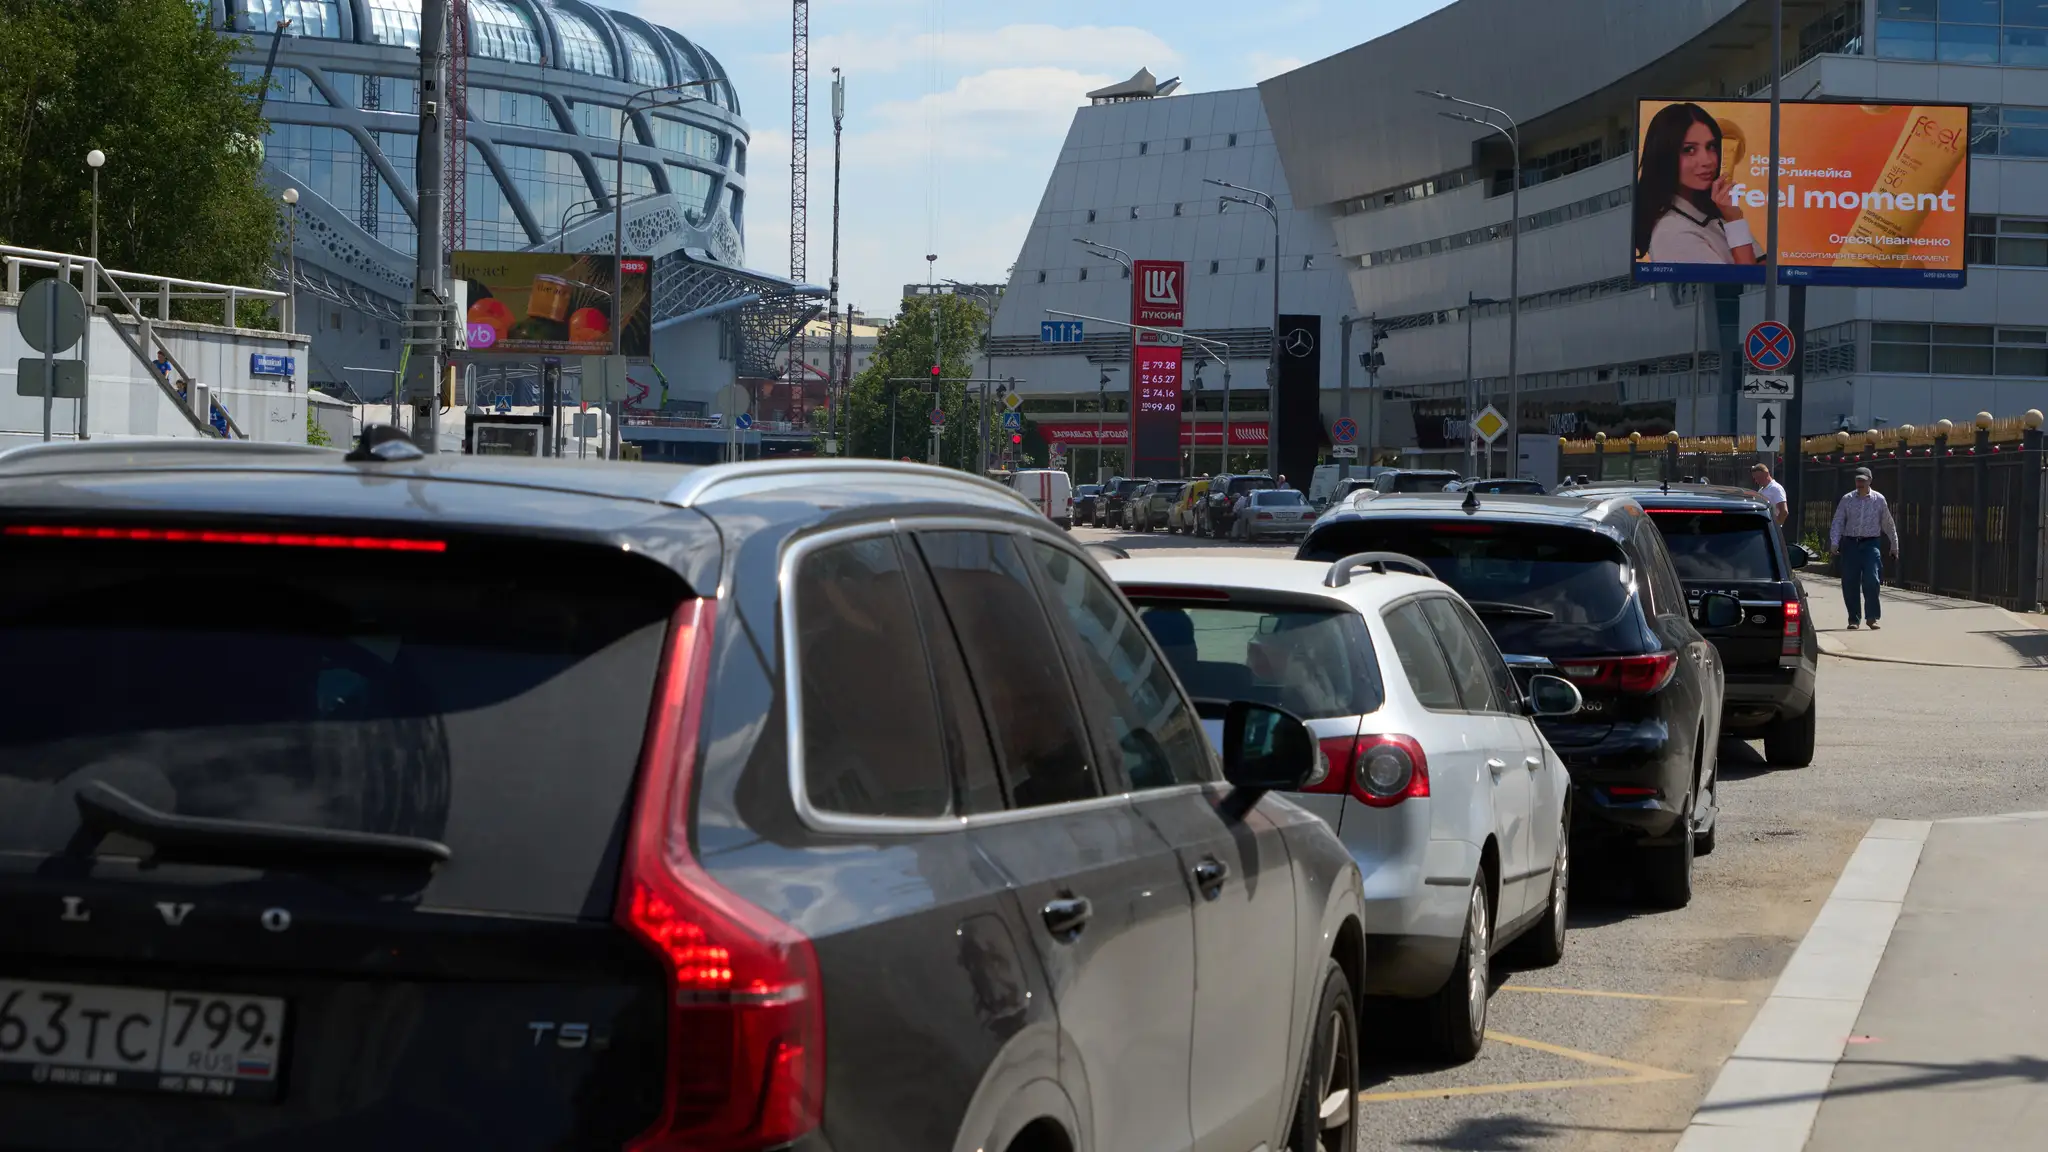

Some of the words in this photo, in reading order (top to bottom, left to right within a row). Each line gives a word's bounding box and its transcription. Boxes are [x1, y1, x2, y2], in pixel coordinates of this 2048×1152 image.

[1750, 154, 1795, 165] Ноая
[1803, 189, 1956, 212] moment
[1829, 233, 1873, 245] Олеся
[1875, 235, 1951, 247] Иванченко
[1141, 311, 1182, 320] ЛУКОЙЛ
[1152, 361, 1176, 370] 79.28
[1152, 375, 1176, 384] 65.27
[1152, 389, 1175, 398] 74.16
[1151, 403, 1176, 411] 99.40
[172, 997, 267, 1055] 799
[527, 1021, 590, 1049] T5
[187, 1053, 234, 1075] RUS
